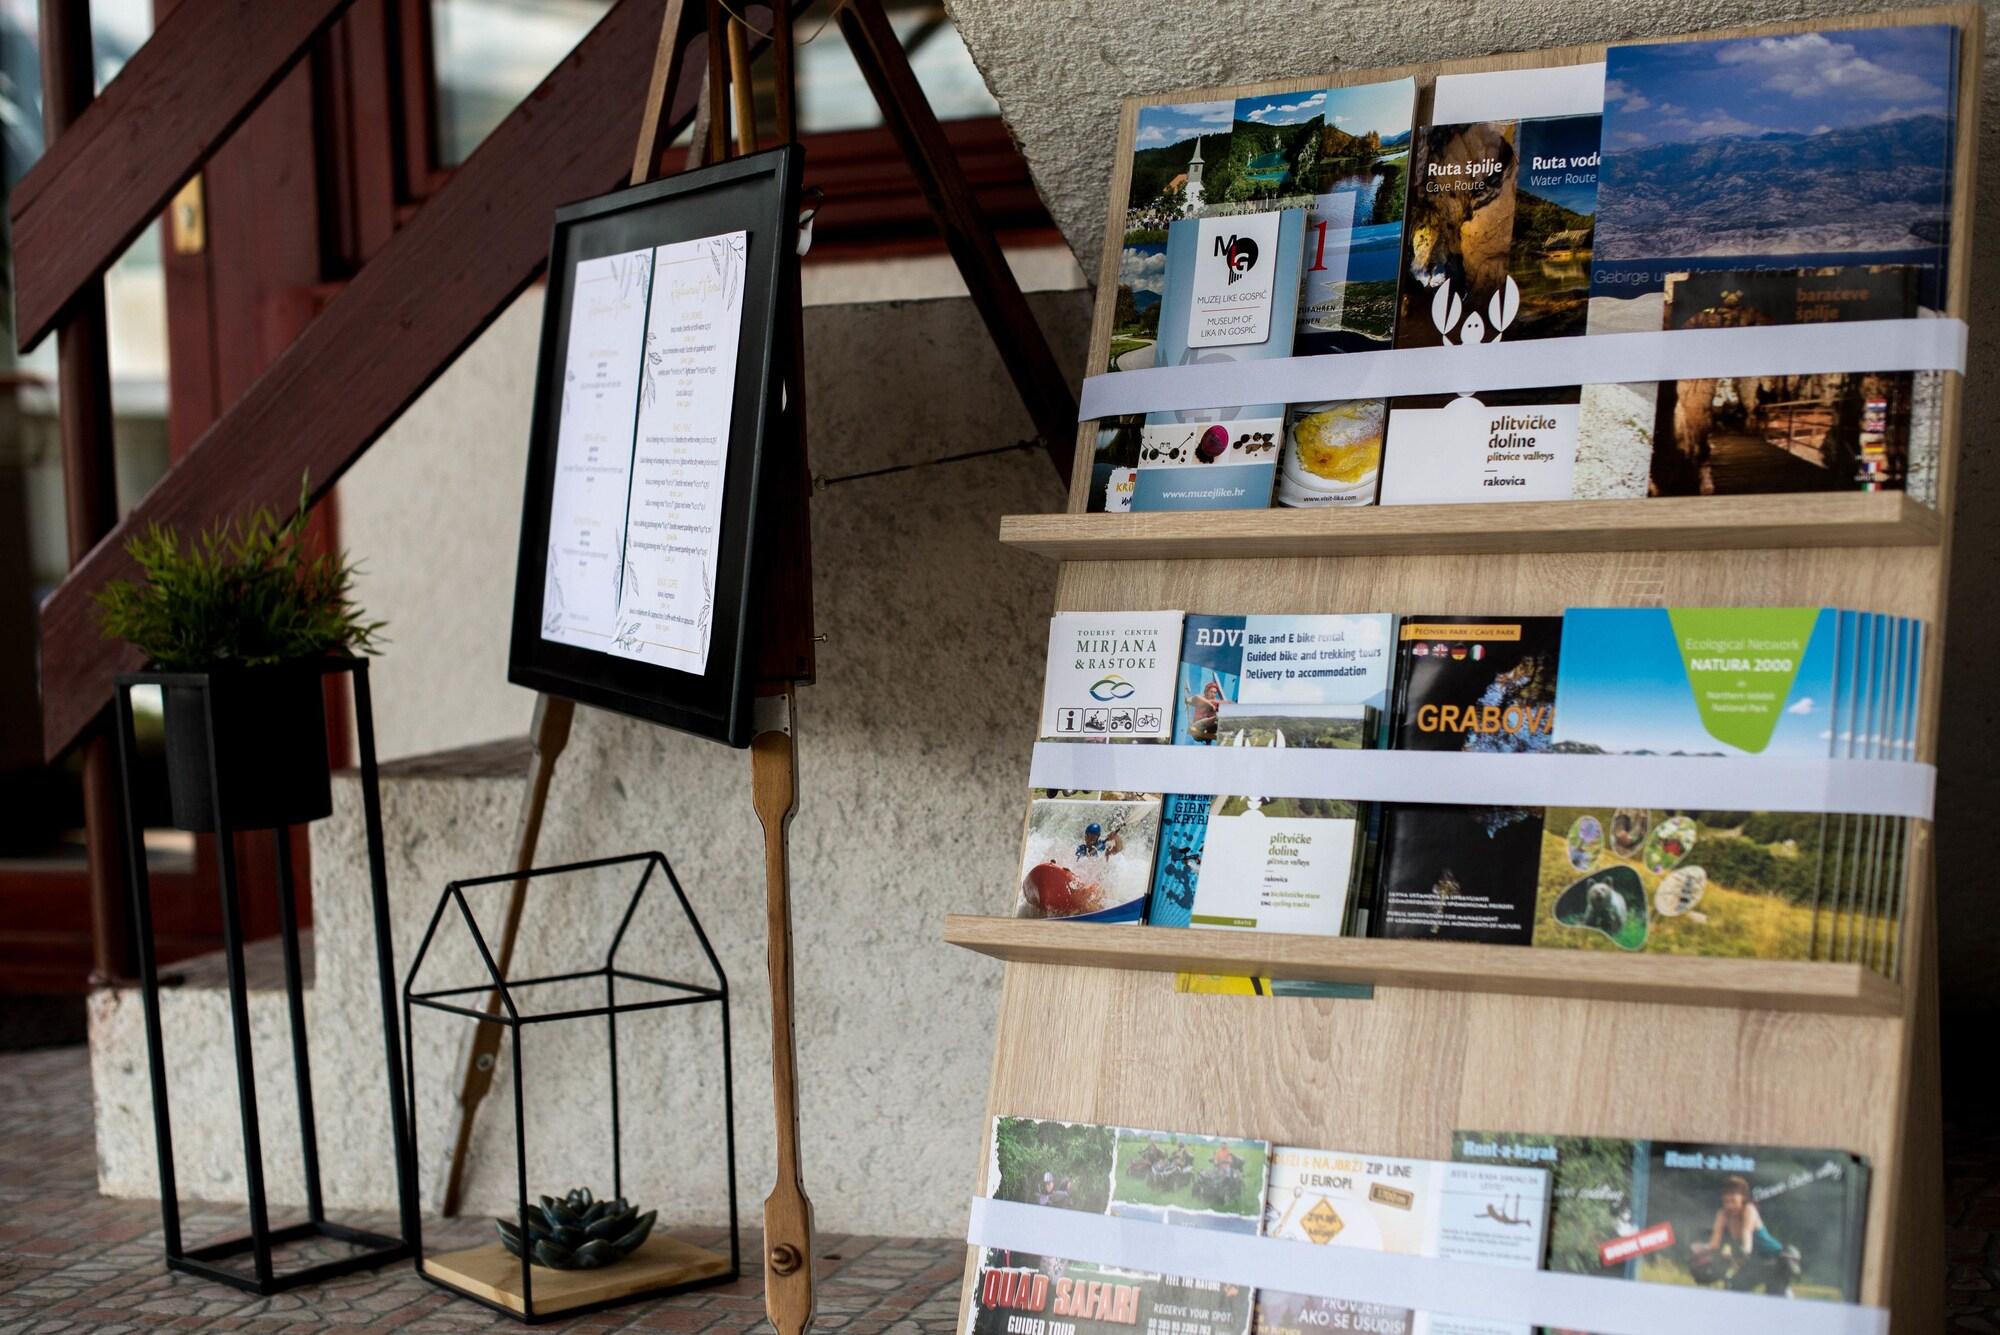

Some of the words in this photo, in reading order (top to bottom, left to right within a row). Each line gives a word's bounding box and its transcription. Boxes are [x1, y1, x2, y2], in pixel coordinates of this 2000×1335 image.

[1428, 163, 1461, 176] Ruta
[1465, 158, 1503, 177] špilje
[1532, 156, 1566, 170] Ruta
[1426, 181, 1450, 193] Cave
[1454, 180, 1485, 192] Route
[1531, 175, 1562, 186] Water
[1565, 173, 1597, 184] Route
[1308, 220, 1328, 272] 1
[1594, 269, 1649, 287] Gebirge
[1197, 295, 1221, 305] MUZEJ
[1223, 294, 1237, 303] LIKE
[1239, 290, 1267, 302] GOSPIĆ
[1207, 316, 1240, 326] MUSEUM
[1242, 315, 1253, 324] OF
[1201, 329, 1216, 338] LIKA
[1218, 328, 1227, 336] IN
[1228, 324, 1257, 336] GOSPIĆ
[1490, 414, 1557, 434] plitvičke
[1488, 433, 1536, 449] doline
[1486, 451, 1520, 464] plitvice
[1523, 451, 1555, 464] valleys
[1483, 476, 1526, 487] rakovica
[1162, 487, 1246, 500] www.muzejlike.hr
[1248, 634, 1267, 645] Bike
[1269, 633, 1286, 644] and
[1288, 633, 1294, 643] E
[1297, 632, 1316, 643] bike
[1685, 638, 1743, 653] Ecological
[1077, 640, 1157, 655] MIRJANA
[1247, 651, 1277, 662] Guided
[1279, 650, 1298, 661] bike
[1300, 650, 1317, 660] and
[1320, 648, 1356, 662] trekking
[1088, 658, 1157, 669] RASTOKE
[1691, 658, 1750, 671] NATURA
[1754, 658, 1792, 672] 2000
[1246, 668, 1282, 681] Delivery
[1285, 669, 1295, 679] to
[1298, 666, 1367, 679] accommodation
[1270, 832, 1312, 845] plitvičke
[1268, 845, 1299, 856] doline
[1366, 1161, 1384, 1176] ZIP
[1387, 1163, 1413, 1178] LINE
[1300, 1173, 1308, 1185] U
[1312, 1174, 1353, 1190] EUROPI
[982, 1268, 1048, 1311] QUAD
[1054, 1277, 1141, 1326] SAFARI
[1154, 1303, 1187, 1317] RESERVE
[1190, 1308, 1210, 1320] YOUR
[1298, 1309, 1330, 1326] AKO
[1334, 1313, 1350, 1329] SE
[1007, 1315, 1044, 1335] GUIDED
